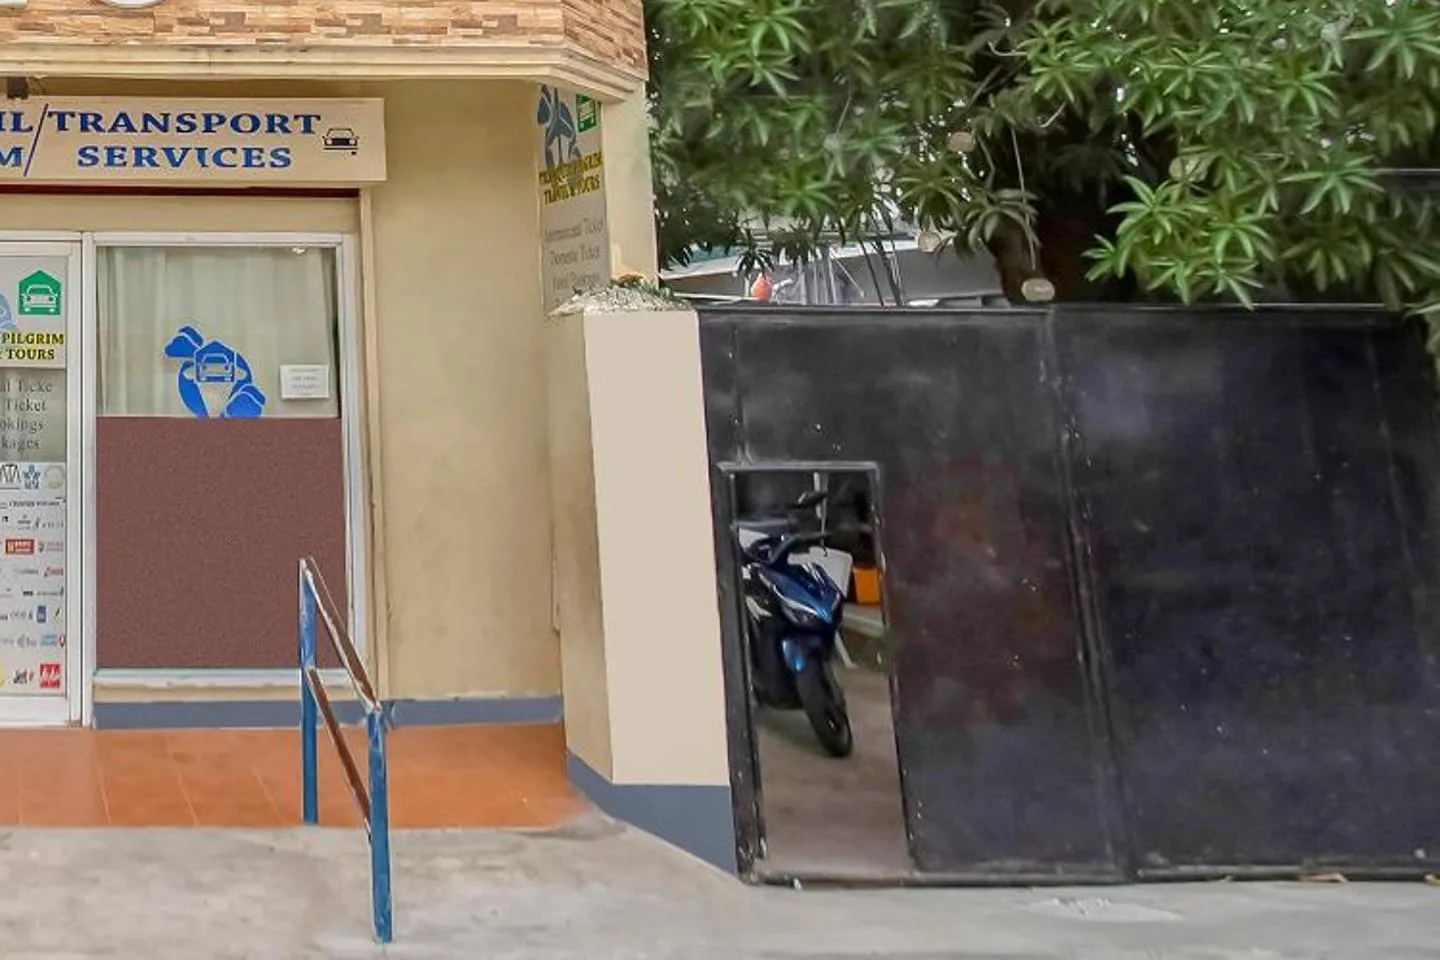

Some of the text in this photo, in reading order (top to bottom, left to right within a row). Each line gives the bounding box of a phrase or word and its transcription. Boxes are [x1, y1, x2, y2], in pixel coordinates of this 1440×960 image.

[47, 110, 322, 135] TRANSPORT
[76, 145, 293, 169] SERVICES
[0, 331, 65, 345] PILGRIM
[4, 347, 56, 360] TOURS
